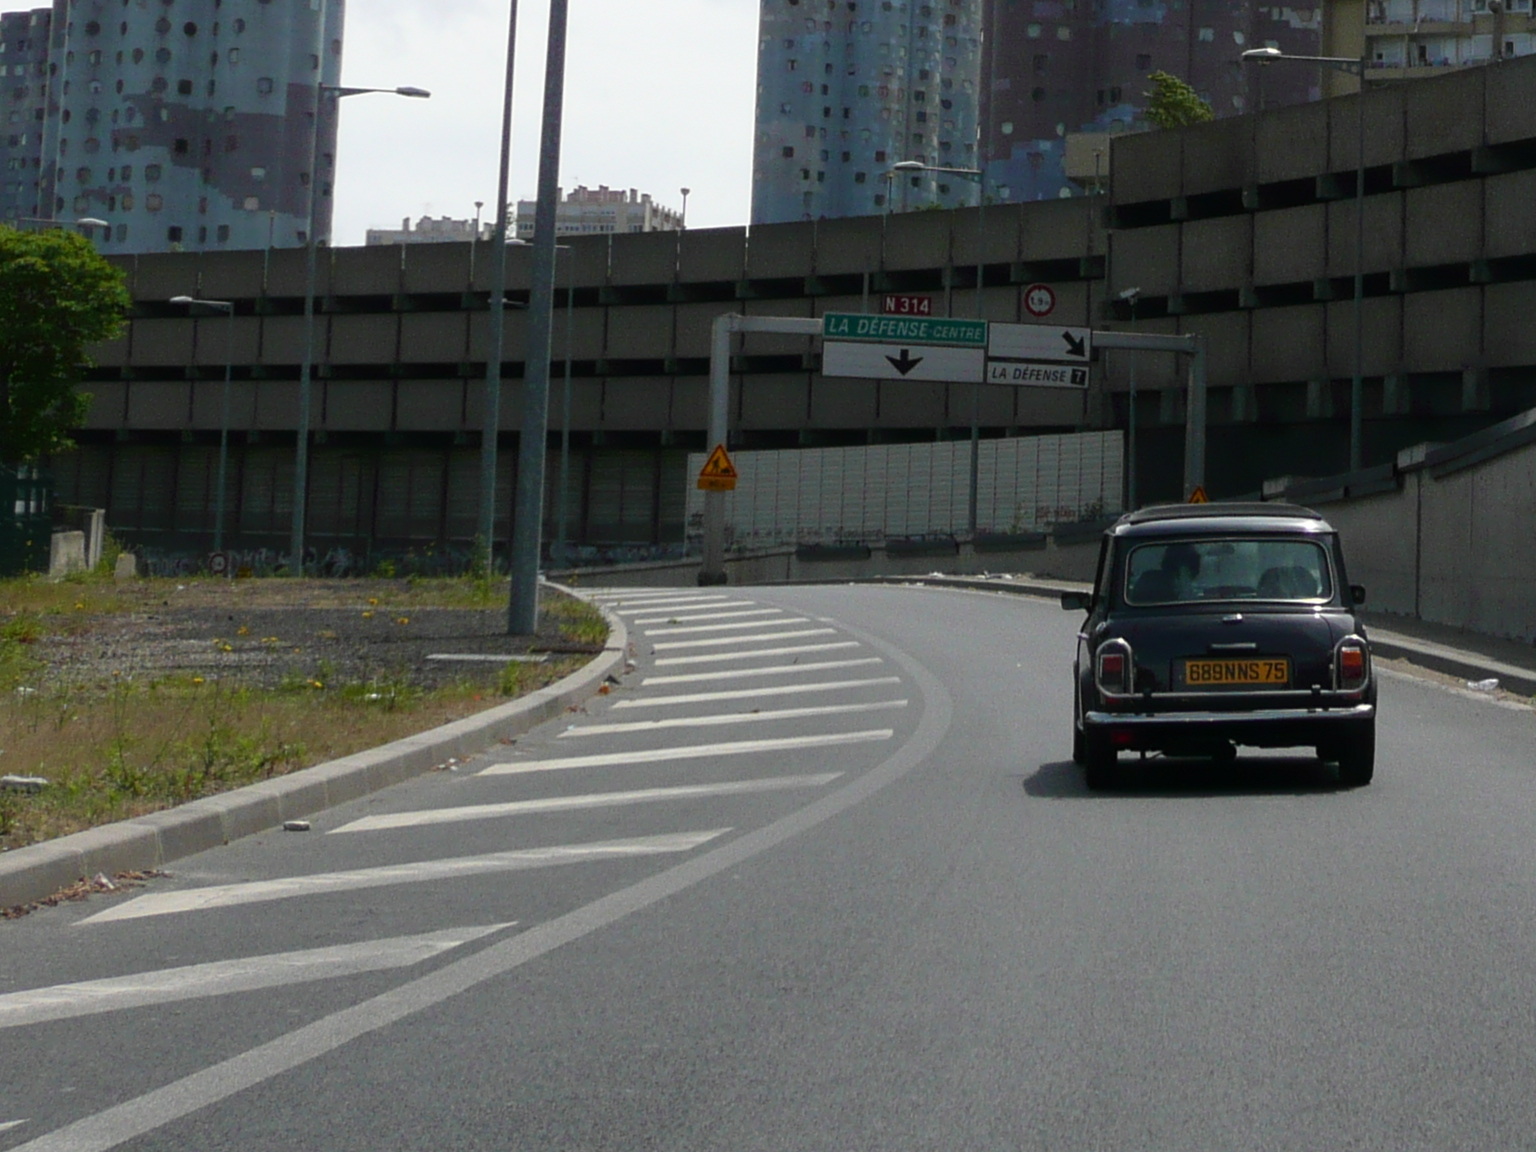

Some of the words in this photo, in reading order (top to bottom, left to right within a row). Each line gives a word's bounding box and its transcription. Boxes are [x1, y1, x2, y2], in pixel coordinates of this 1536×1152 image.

[885, 296, 895, 312] N
[900, 297, 930, 314] 314
[829, 317, 849, 334] LA
[857, 316, 929, 337] DÉFENSE
[992, 366, 1007, 379] LA
[1013, 365, 1066, 382] DÉFENSE
